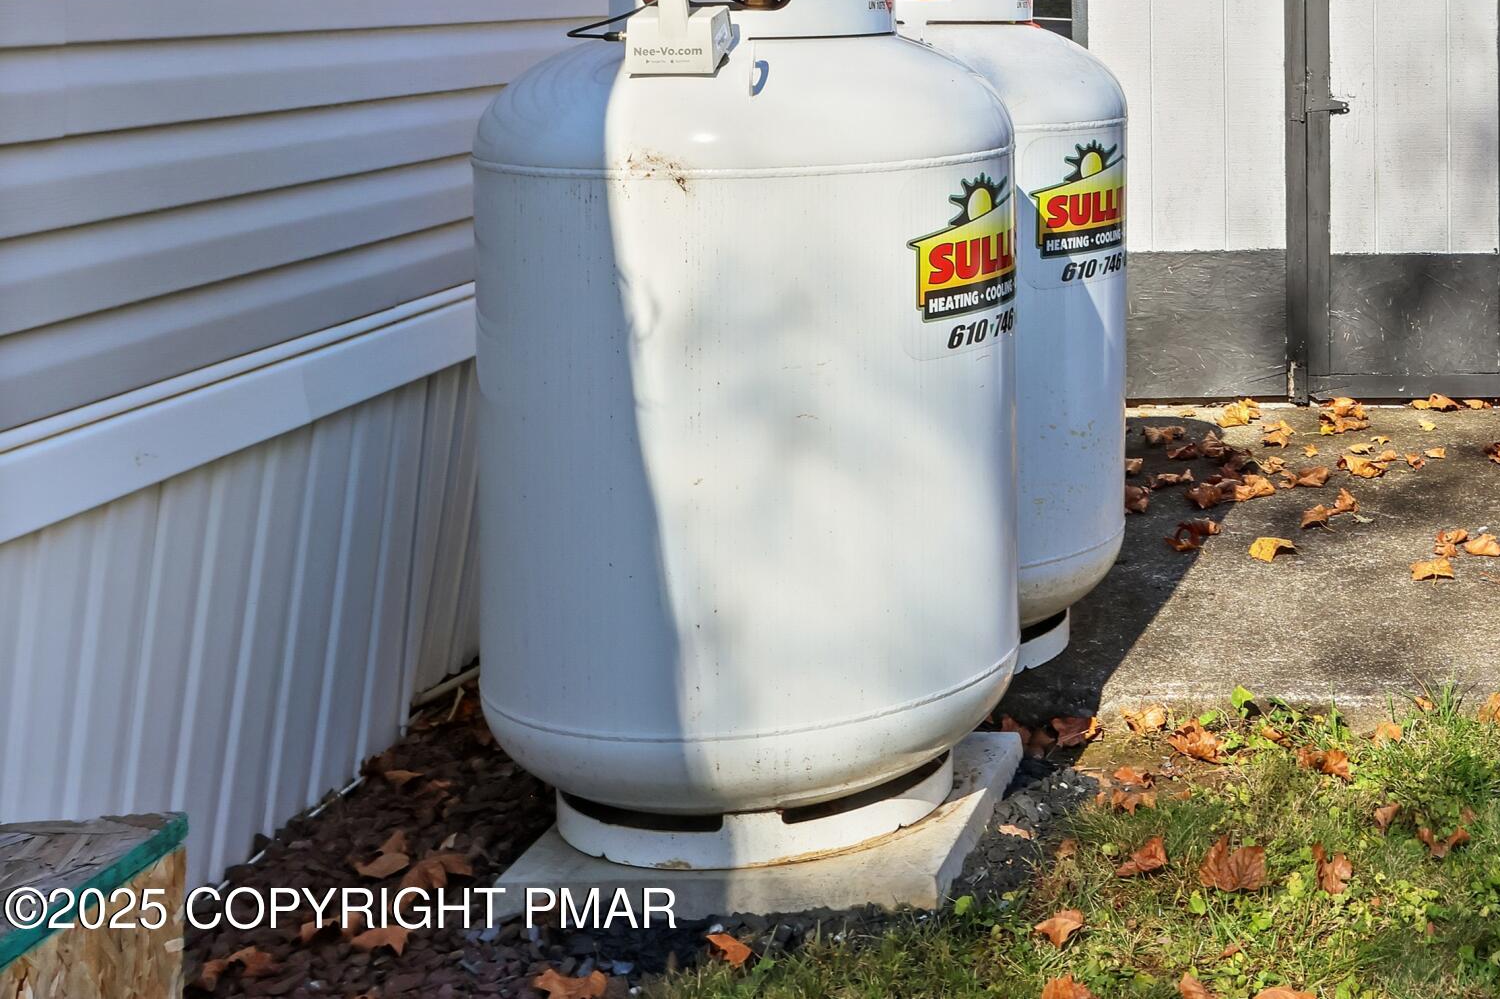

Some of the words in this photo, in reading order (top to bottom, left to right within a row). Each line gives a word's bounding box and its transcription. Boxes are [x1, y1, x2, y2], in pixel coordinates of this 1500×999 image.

[633, 46, 703, 56] Nee-Vo.com
[1046, 236, 1089, 252] HEATING
[929, 291, 979, 314] HEATING
